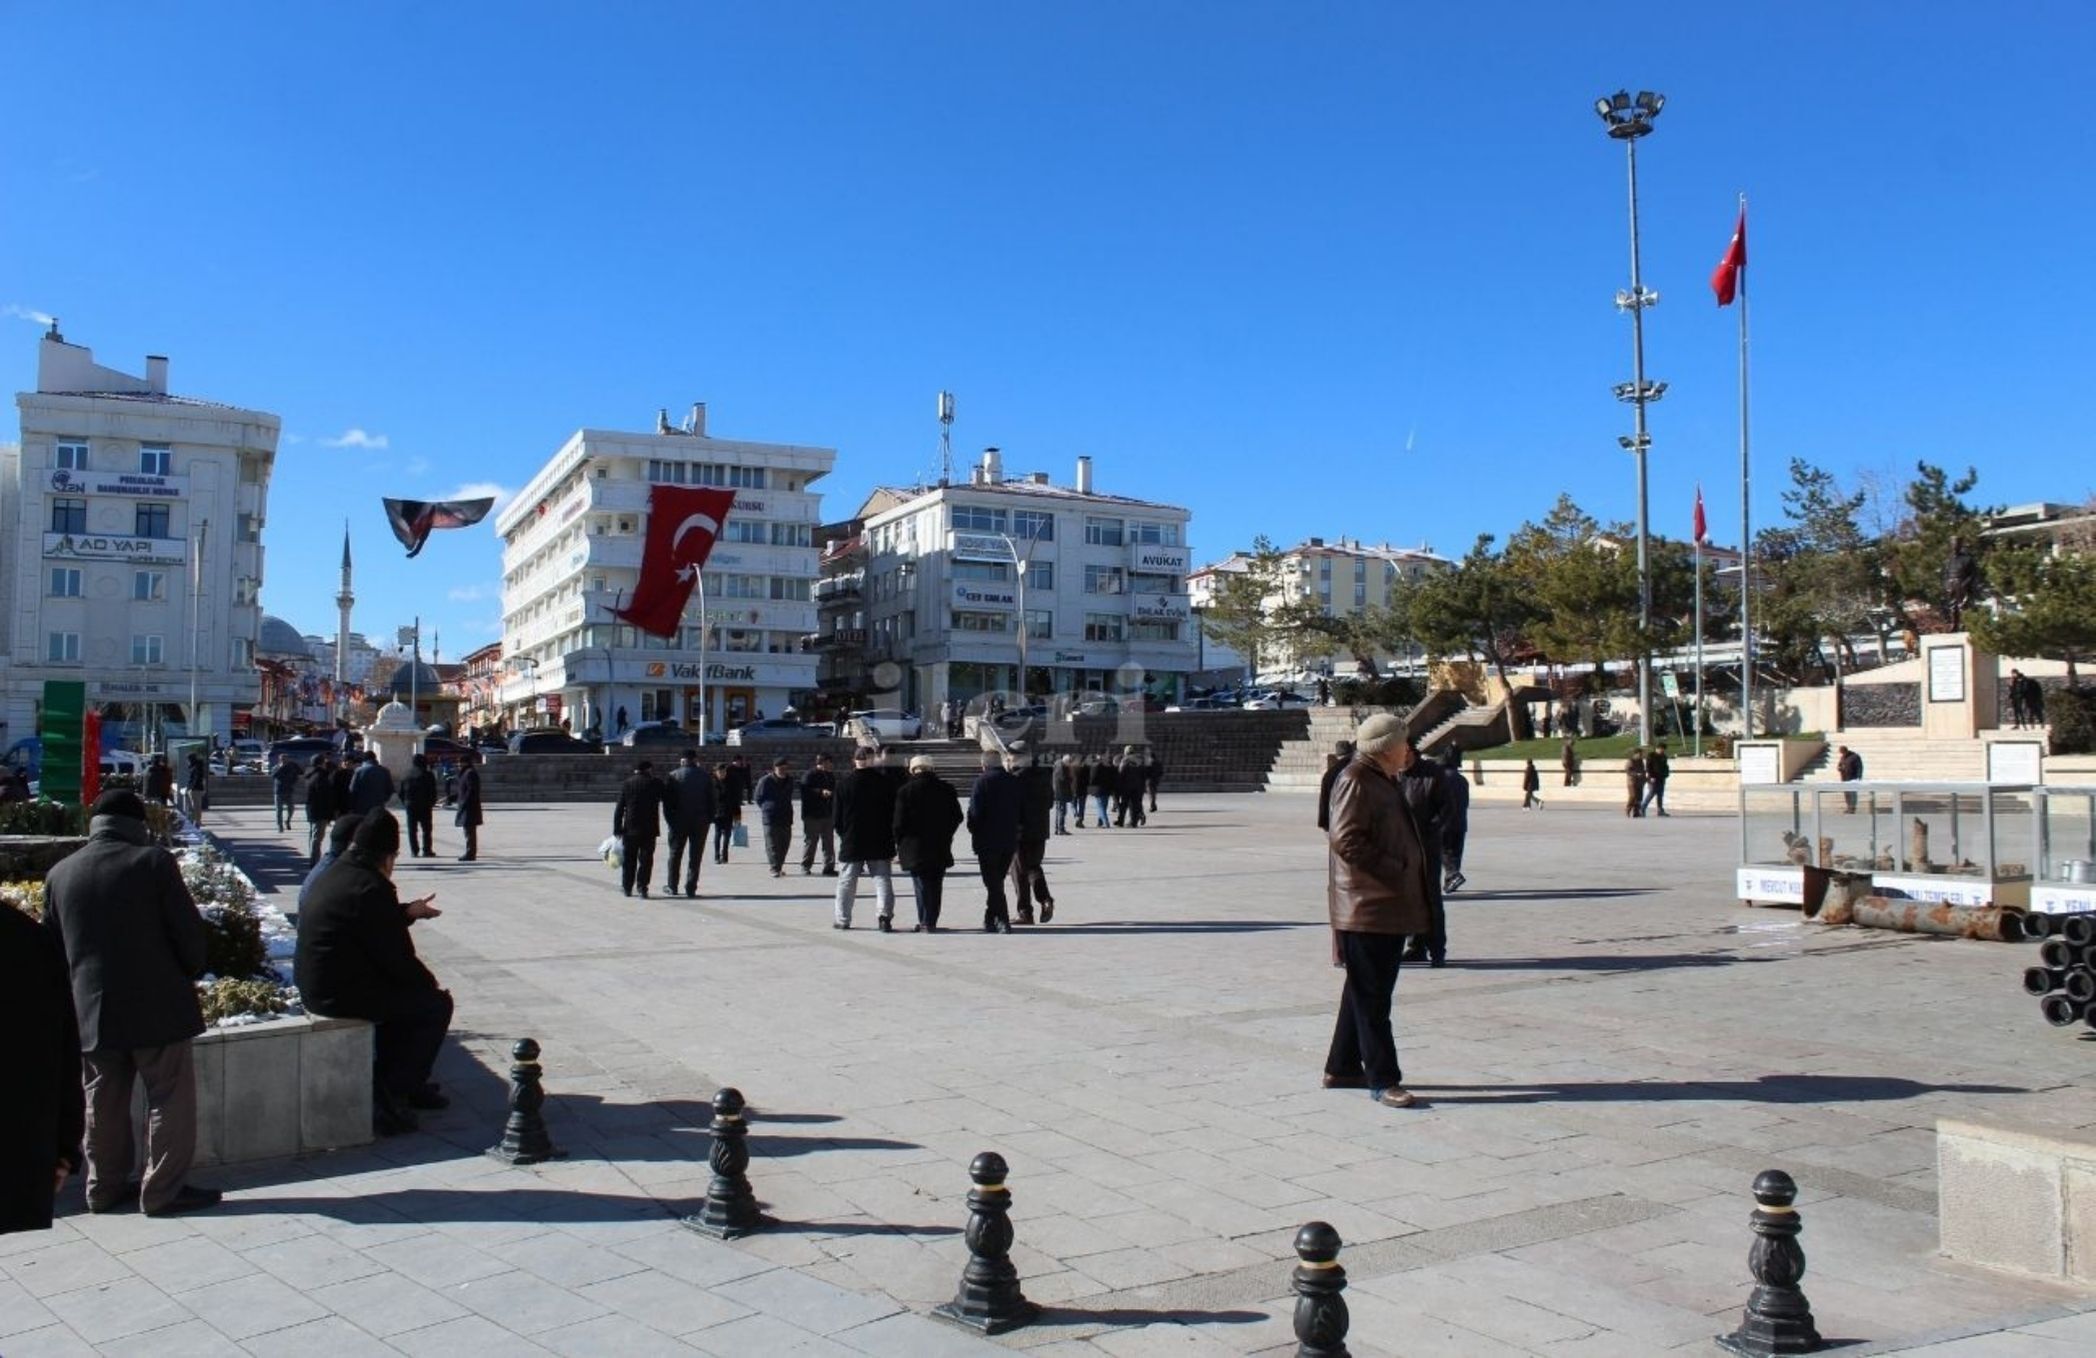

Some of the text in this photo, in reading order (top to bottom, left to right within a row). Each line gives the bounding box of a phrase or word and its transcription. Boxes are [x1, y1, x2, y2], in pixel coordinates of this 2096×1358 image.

[112, 540, 153, 553] YAPI
[1142, 555, 1184, 566] AVUKAT
[671, 663, 755, 680] VakfBank
